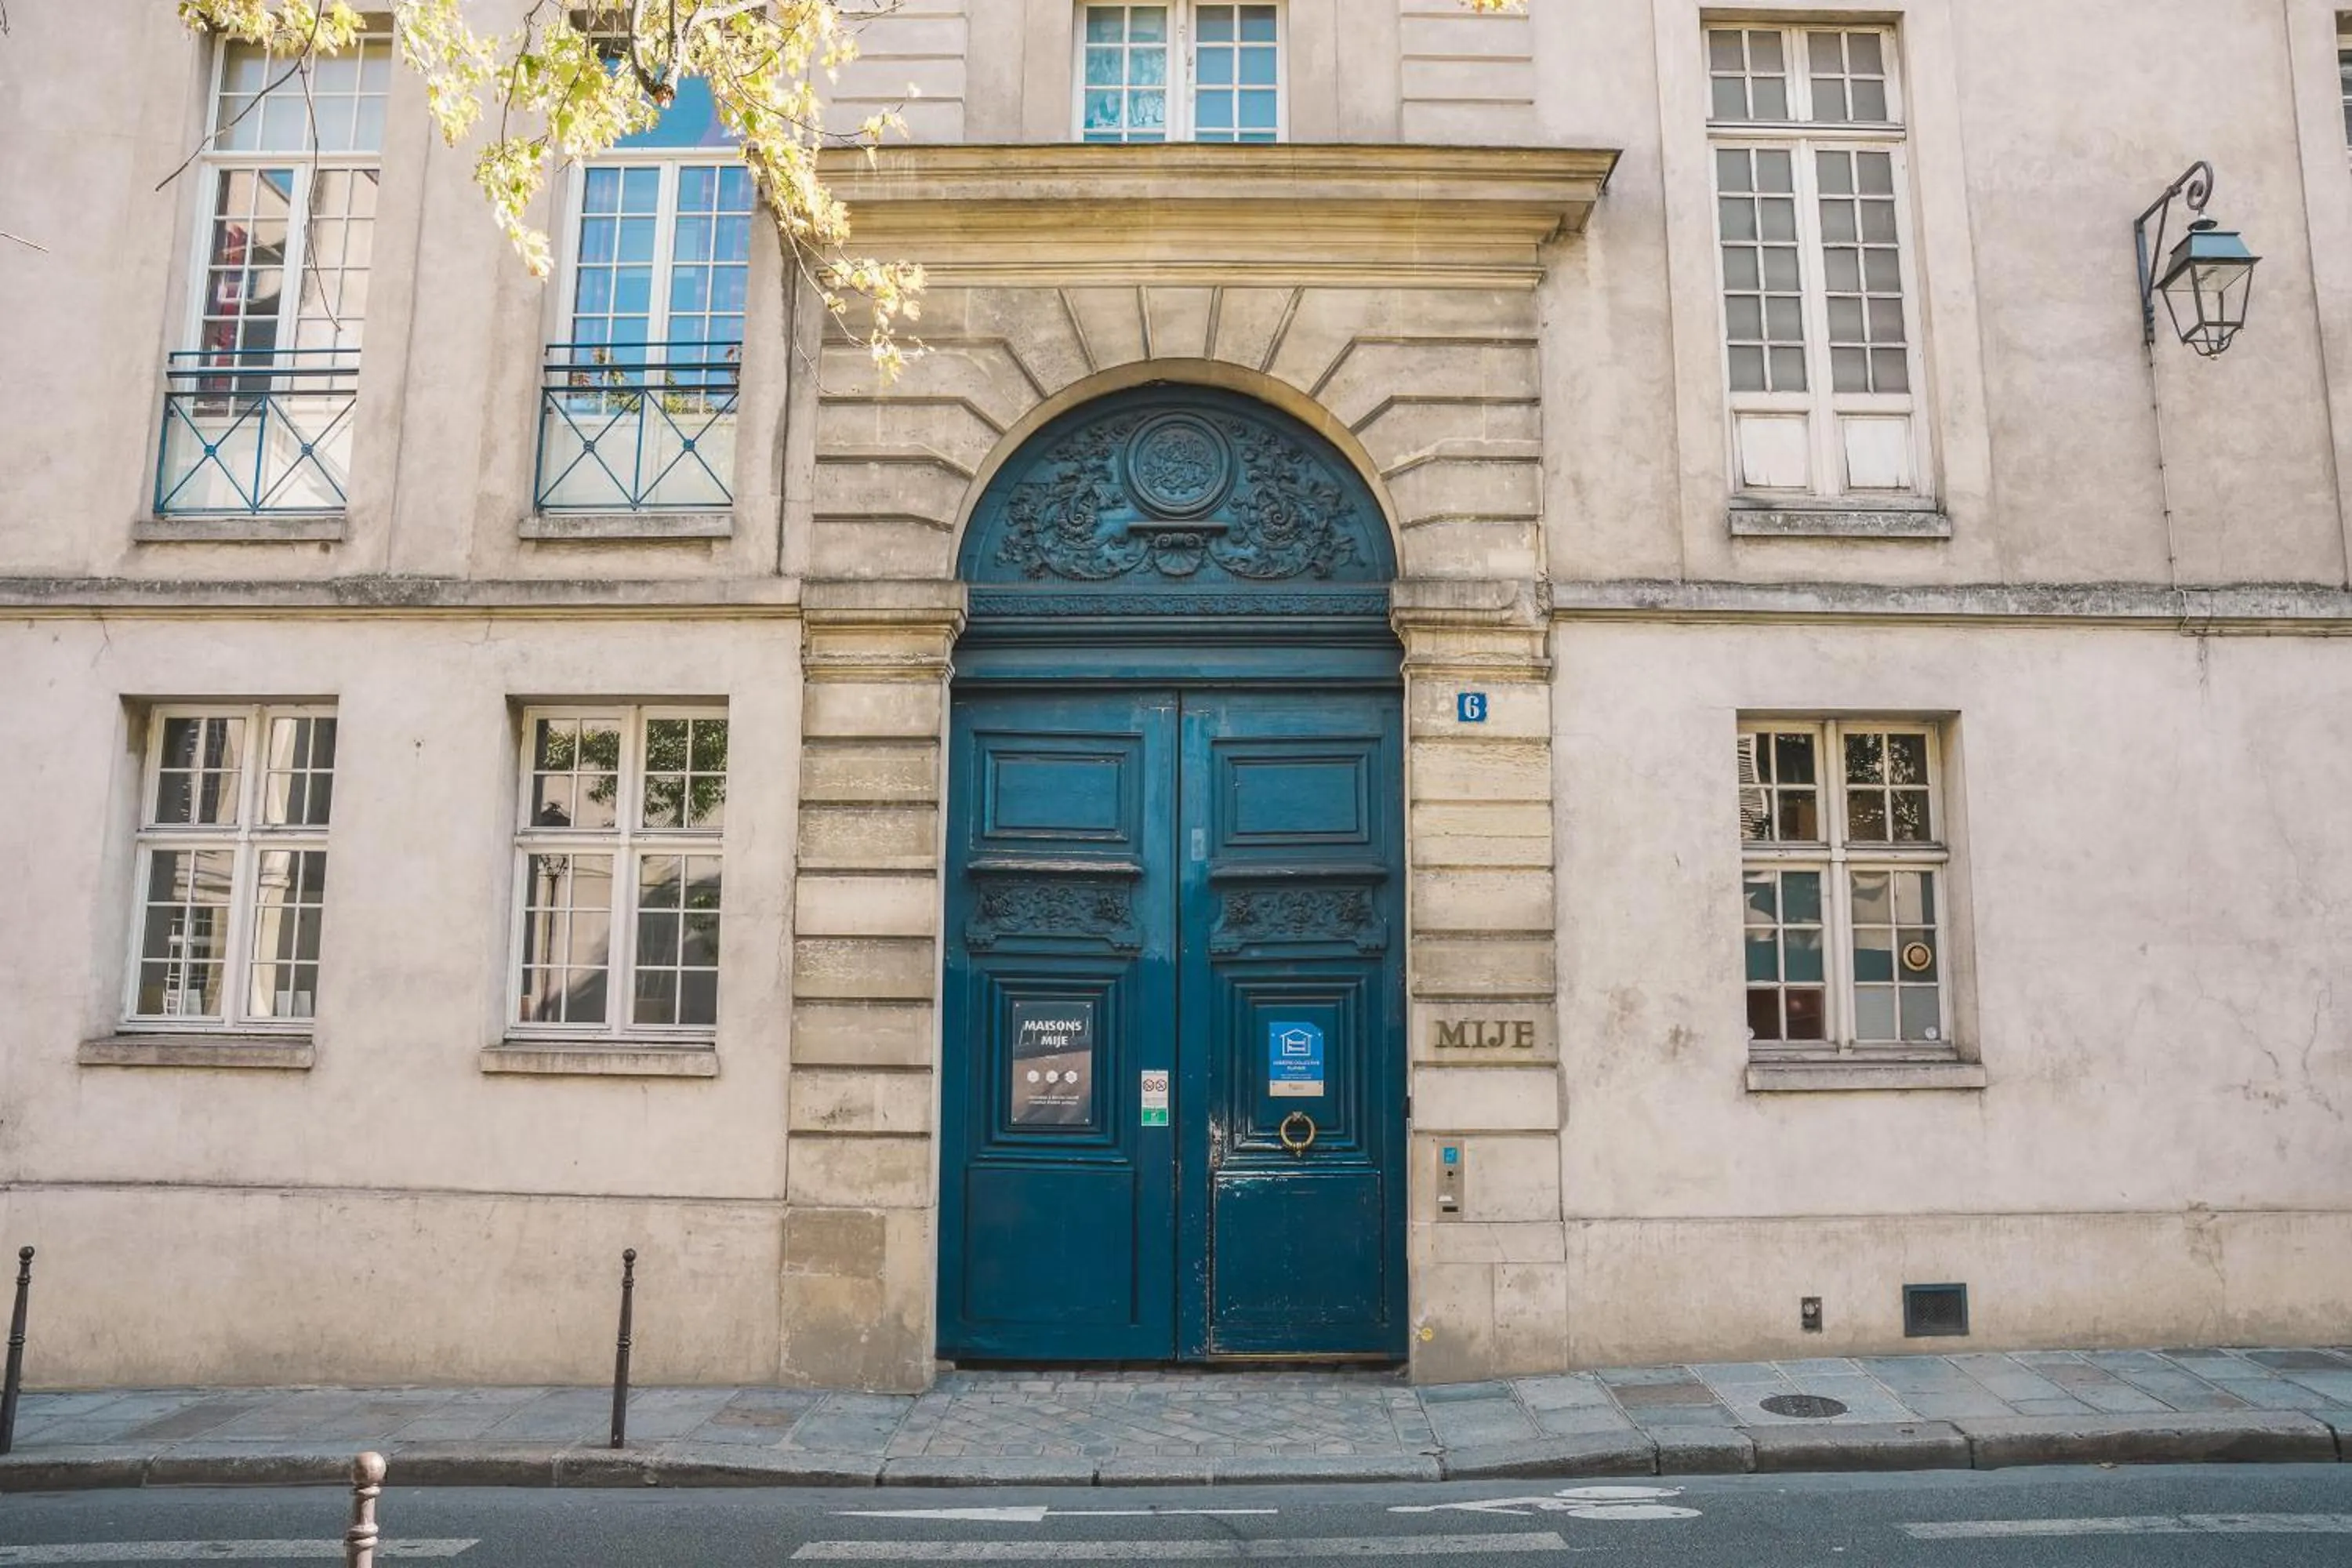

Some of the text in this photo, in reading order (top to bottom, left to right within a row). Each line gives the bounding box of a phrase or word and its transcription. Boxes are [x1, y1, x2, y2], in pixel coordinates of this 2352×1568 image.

[1464, 695, 1480, 719] 6
[1025, 1020, 1082, 1031] MAISONS
[1434, 1019, 1534, 1048] MIJE
[1040, 1036, 1069, 1047] MIJE
